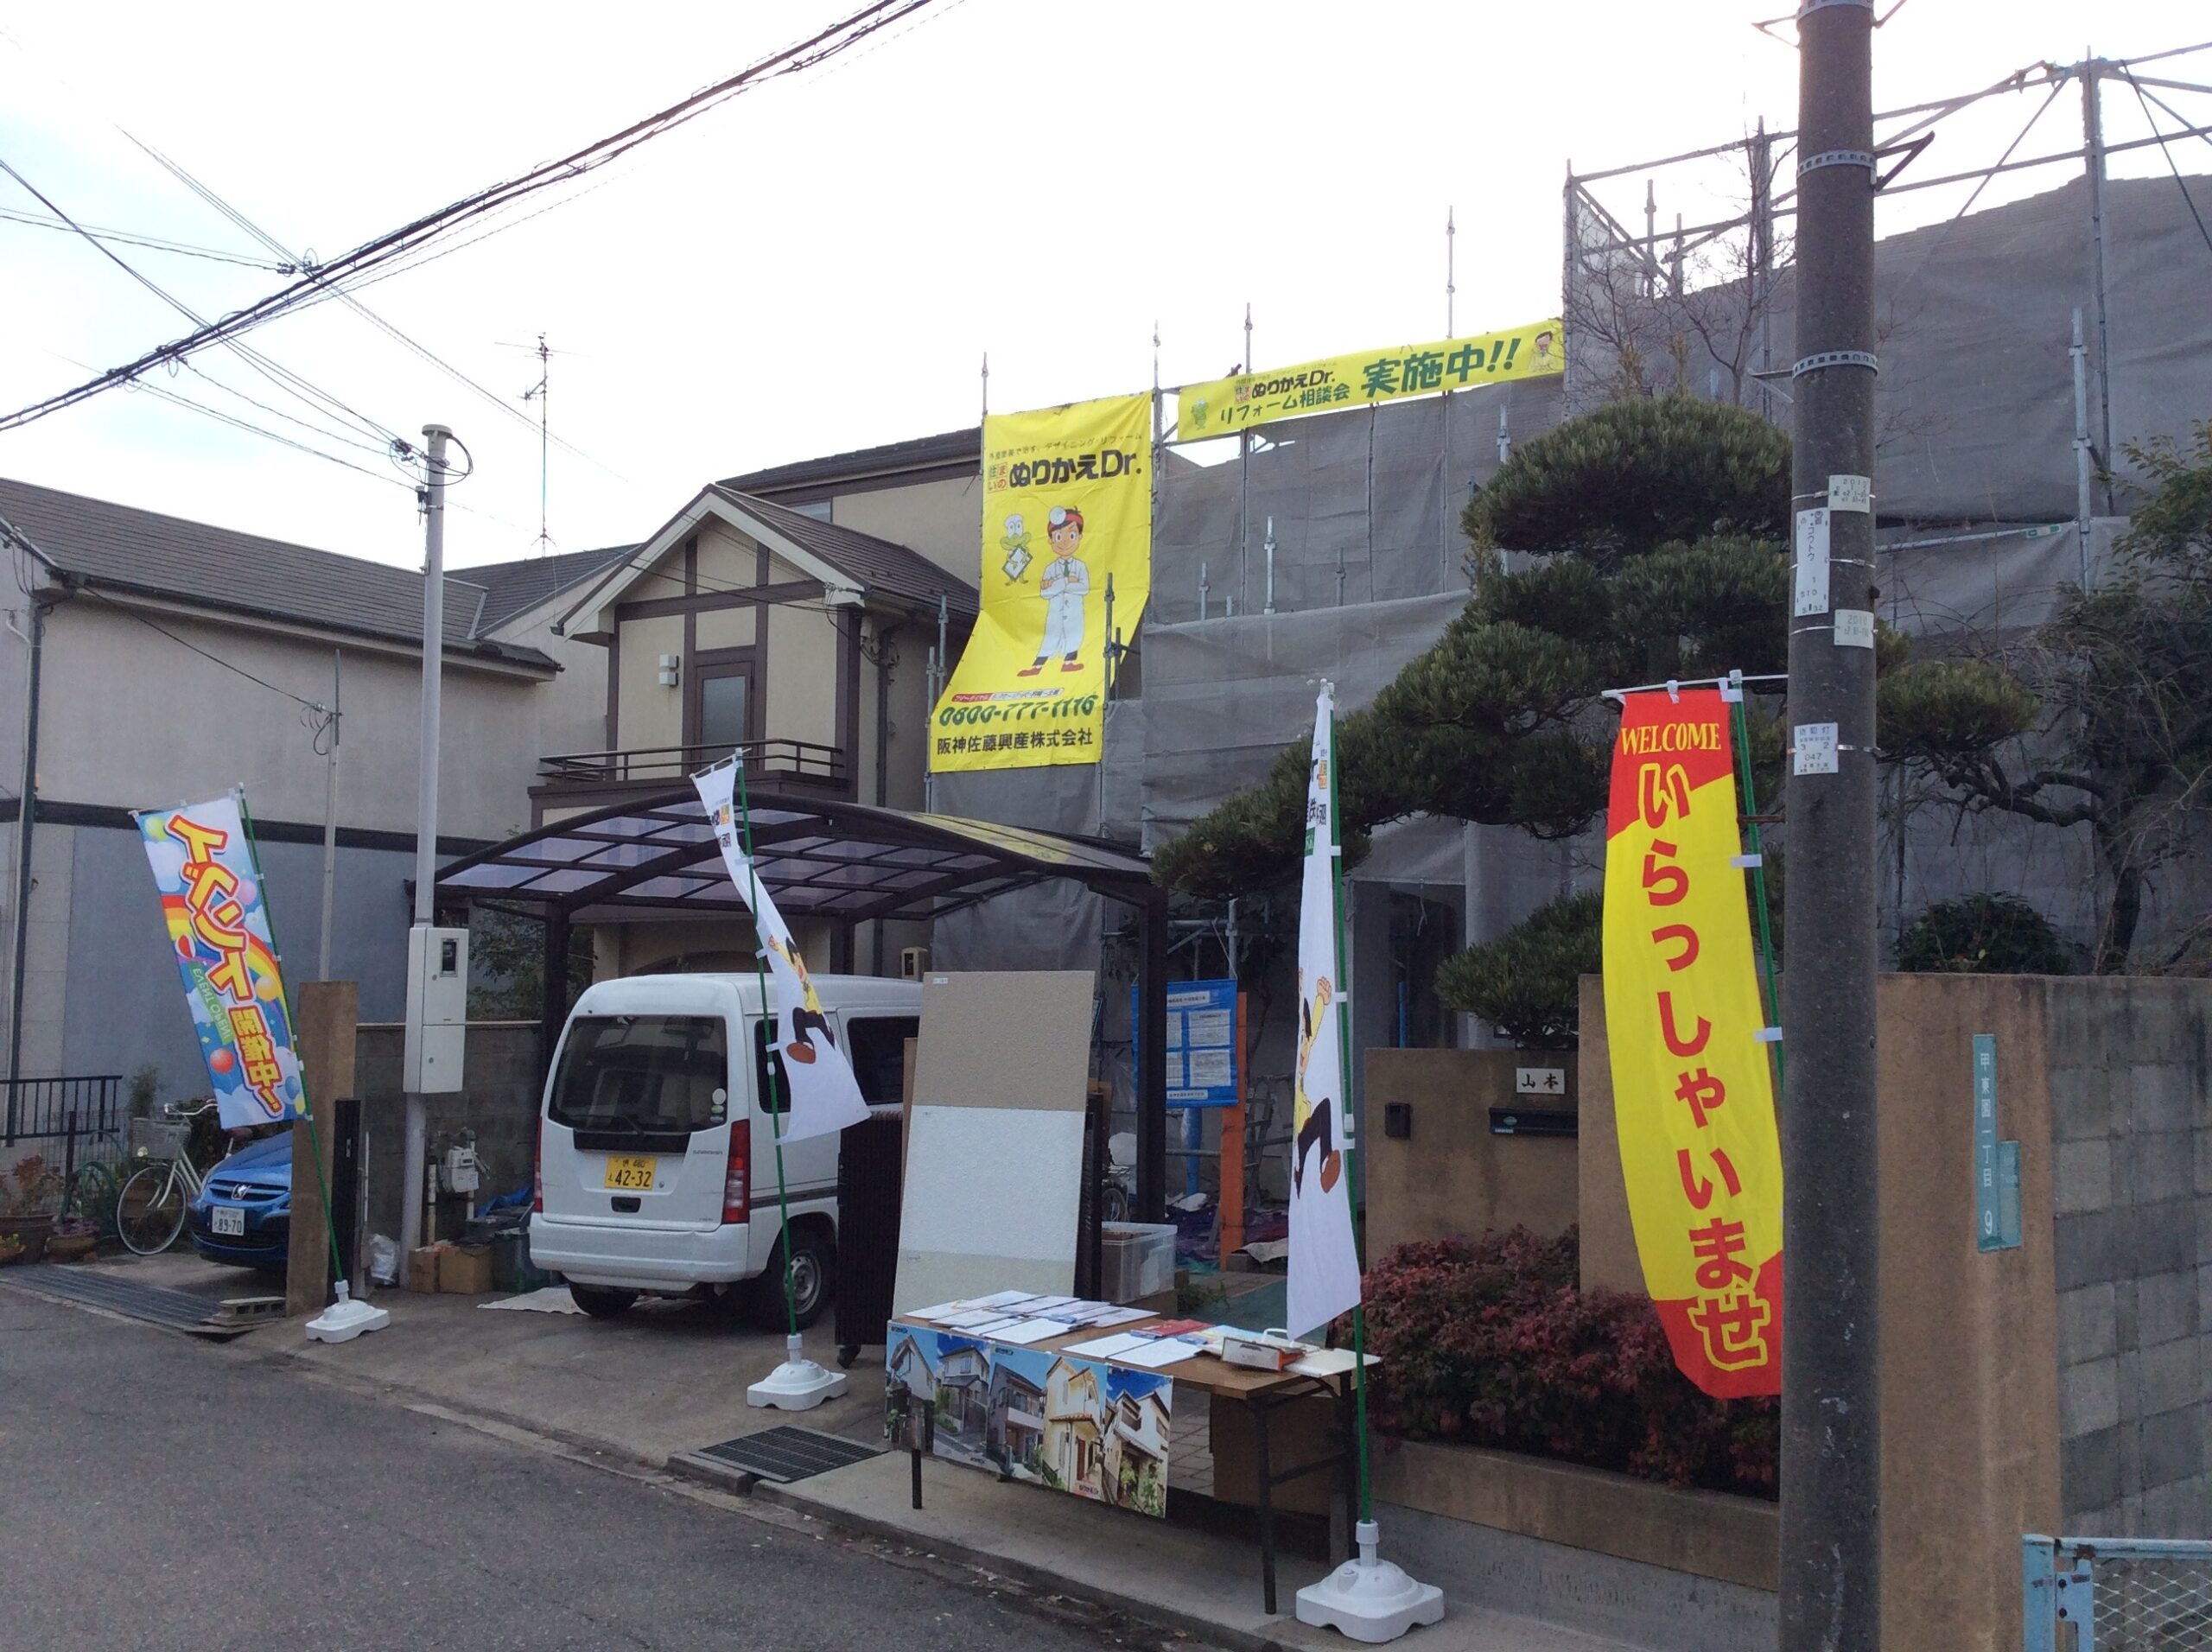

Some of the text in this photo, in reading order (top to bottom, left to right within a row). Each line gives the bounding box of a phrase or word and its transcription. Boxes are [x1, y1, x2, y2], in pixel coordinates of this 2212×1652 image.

[1361, 339, 1522, 397] 実施中!!
[1252, 370, 1335, 398] ぬりかえDr.
[1220, 383, 1351, 424] リフォーム相談会
[1009, 449, 1141, 488] ぬりかえDr.
[938, 694, 1099, 727] 0800-777-1116
[937, 728, 1093, 755] 阪神佐藤興産株式会社
[1620, 722, 1722, 756] WELCOME
[1804, 753, 1822, 761] 047
[1521, 1072, 1559, 1090] 山本
[1639, 763, 1770, 1372] いらっしゃいませ
[615, 1169, 652, 1188] 42-32
[218, 1217, 243, 1234] 89-70
[1984, 1210, 1993, 1236] 9
